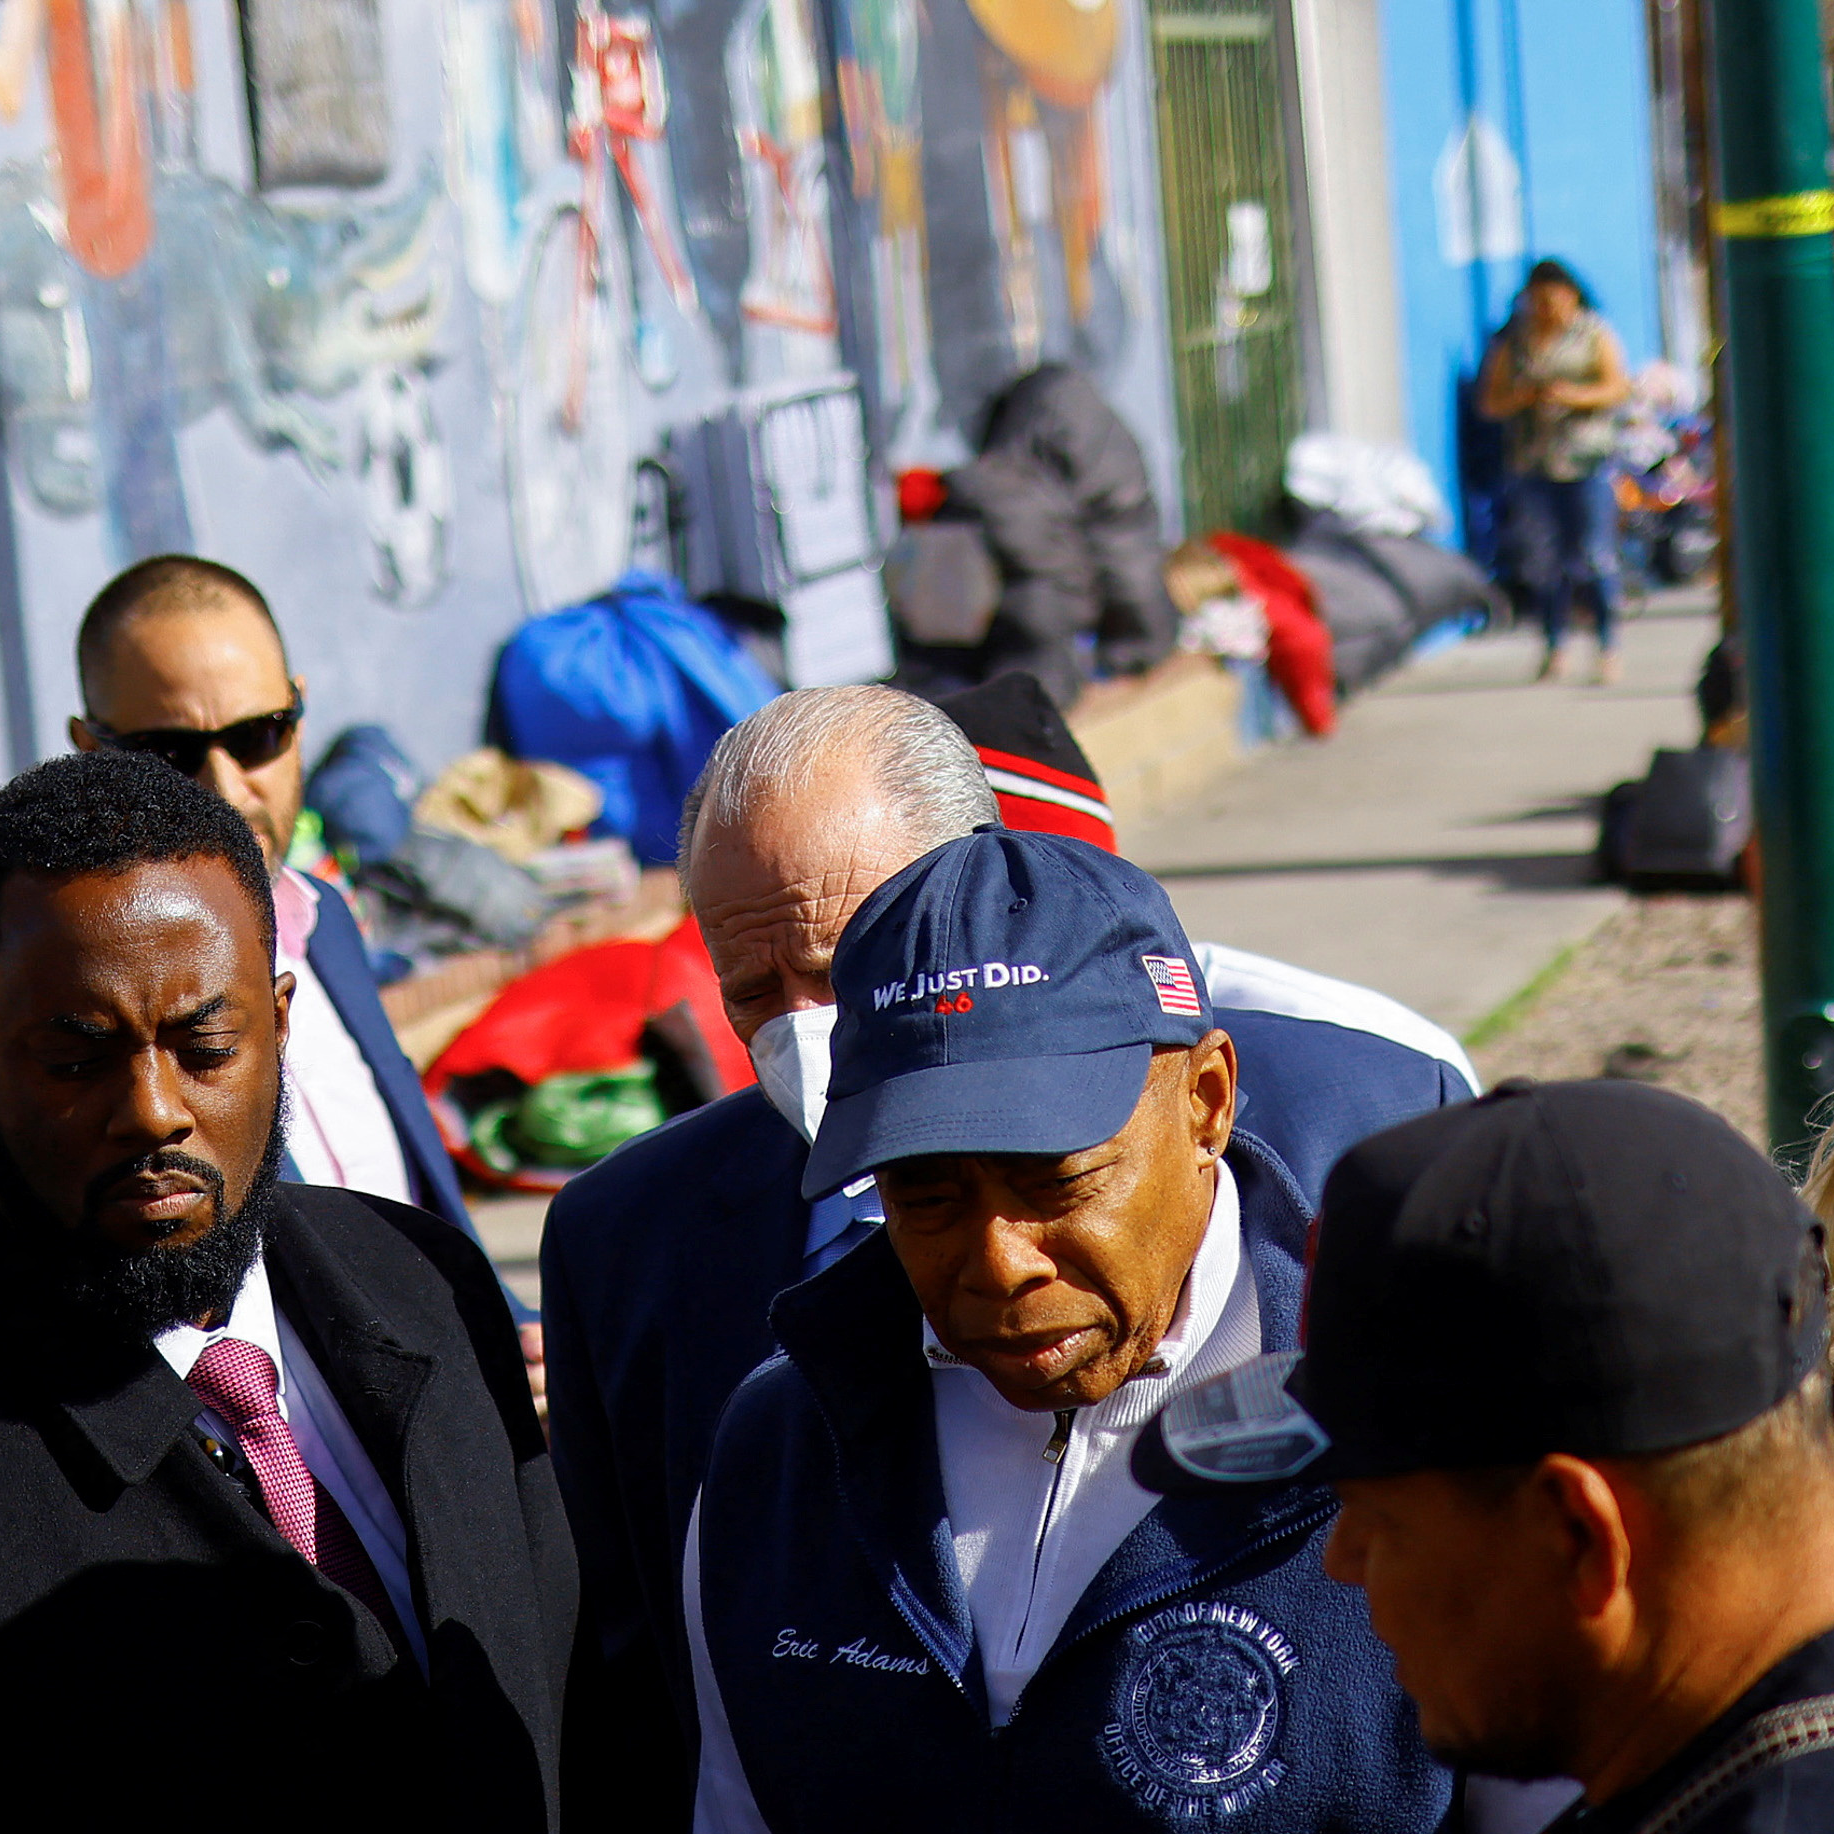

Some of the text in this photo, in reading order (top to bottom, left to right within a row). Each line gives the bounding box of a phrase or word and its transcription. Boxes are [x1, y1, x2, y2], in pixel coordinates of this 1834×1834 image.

[910, 968, 978, 1001] JUST
[934, 992, 974, 1015] 46
[772, 1628, 930, 1675] Eric Adams
[1137, 1601, 1301, 1675] CITY OF NEW YORK
[1104, 1722, 1146, 1788] OFFICE
[1143, 1783, 1168, 1805] OF
[1174, 1795, 1212, 1816] THE
